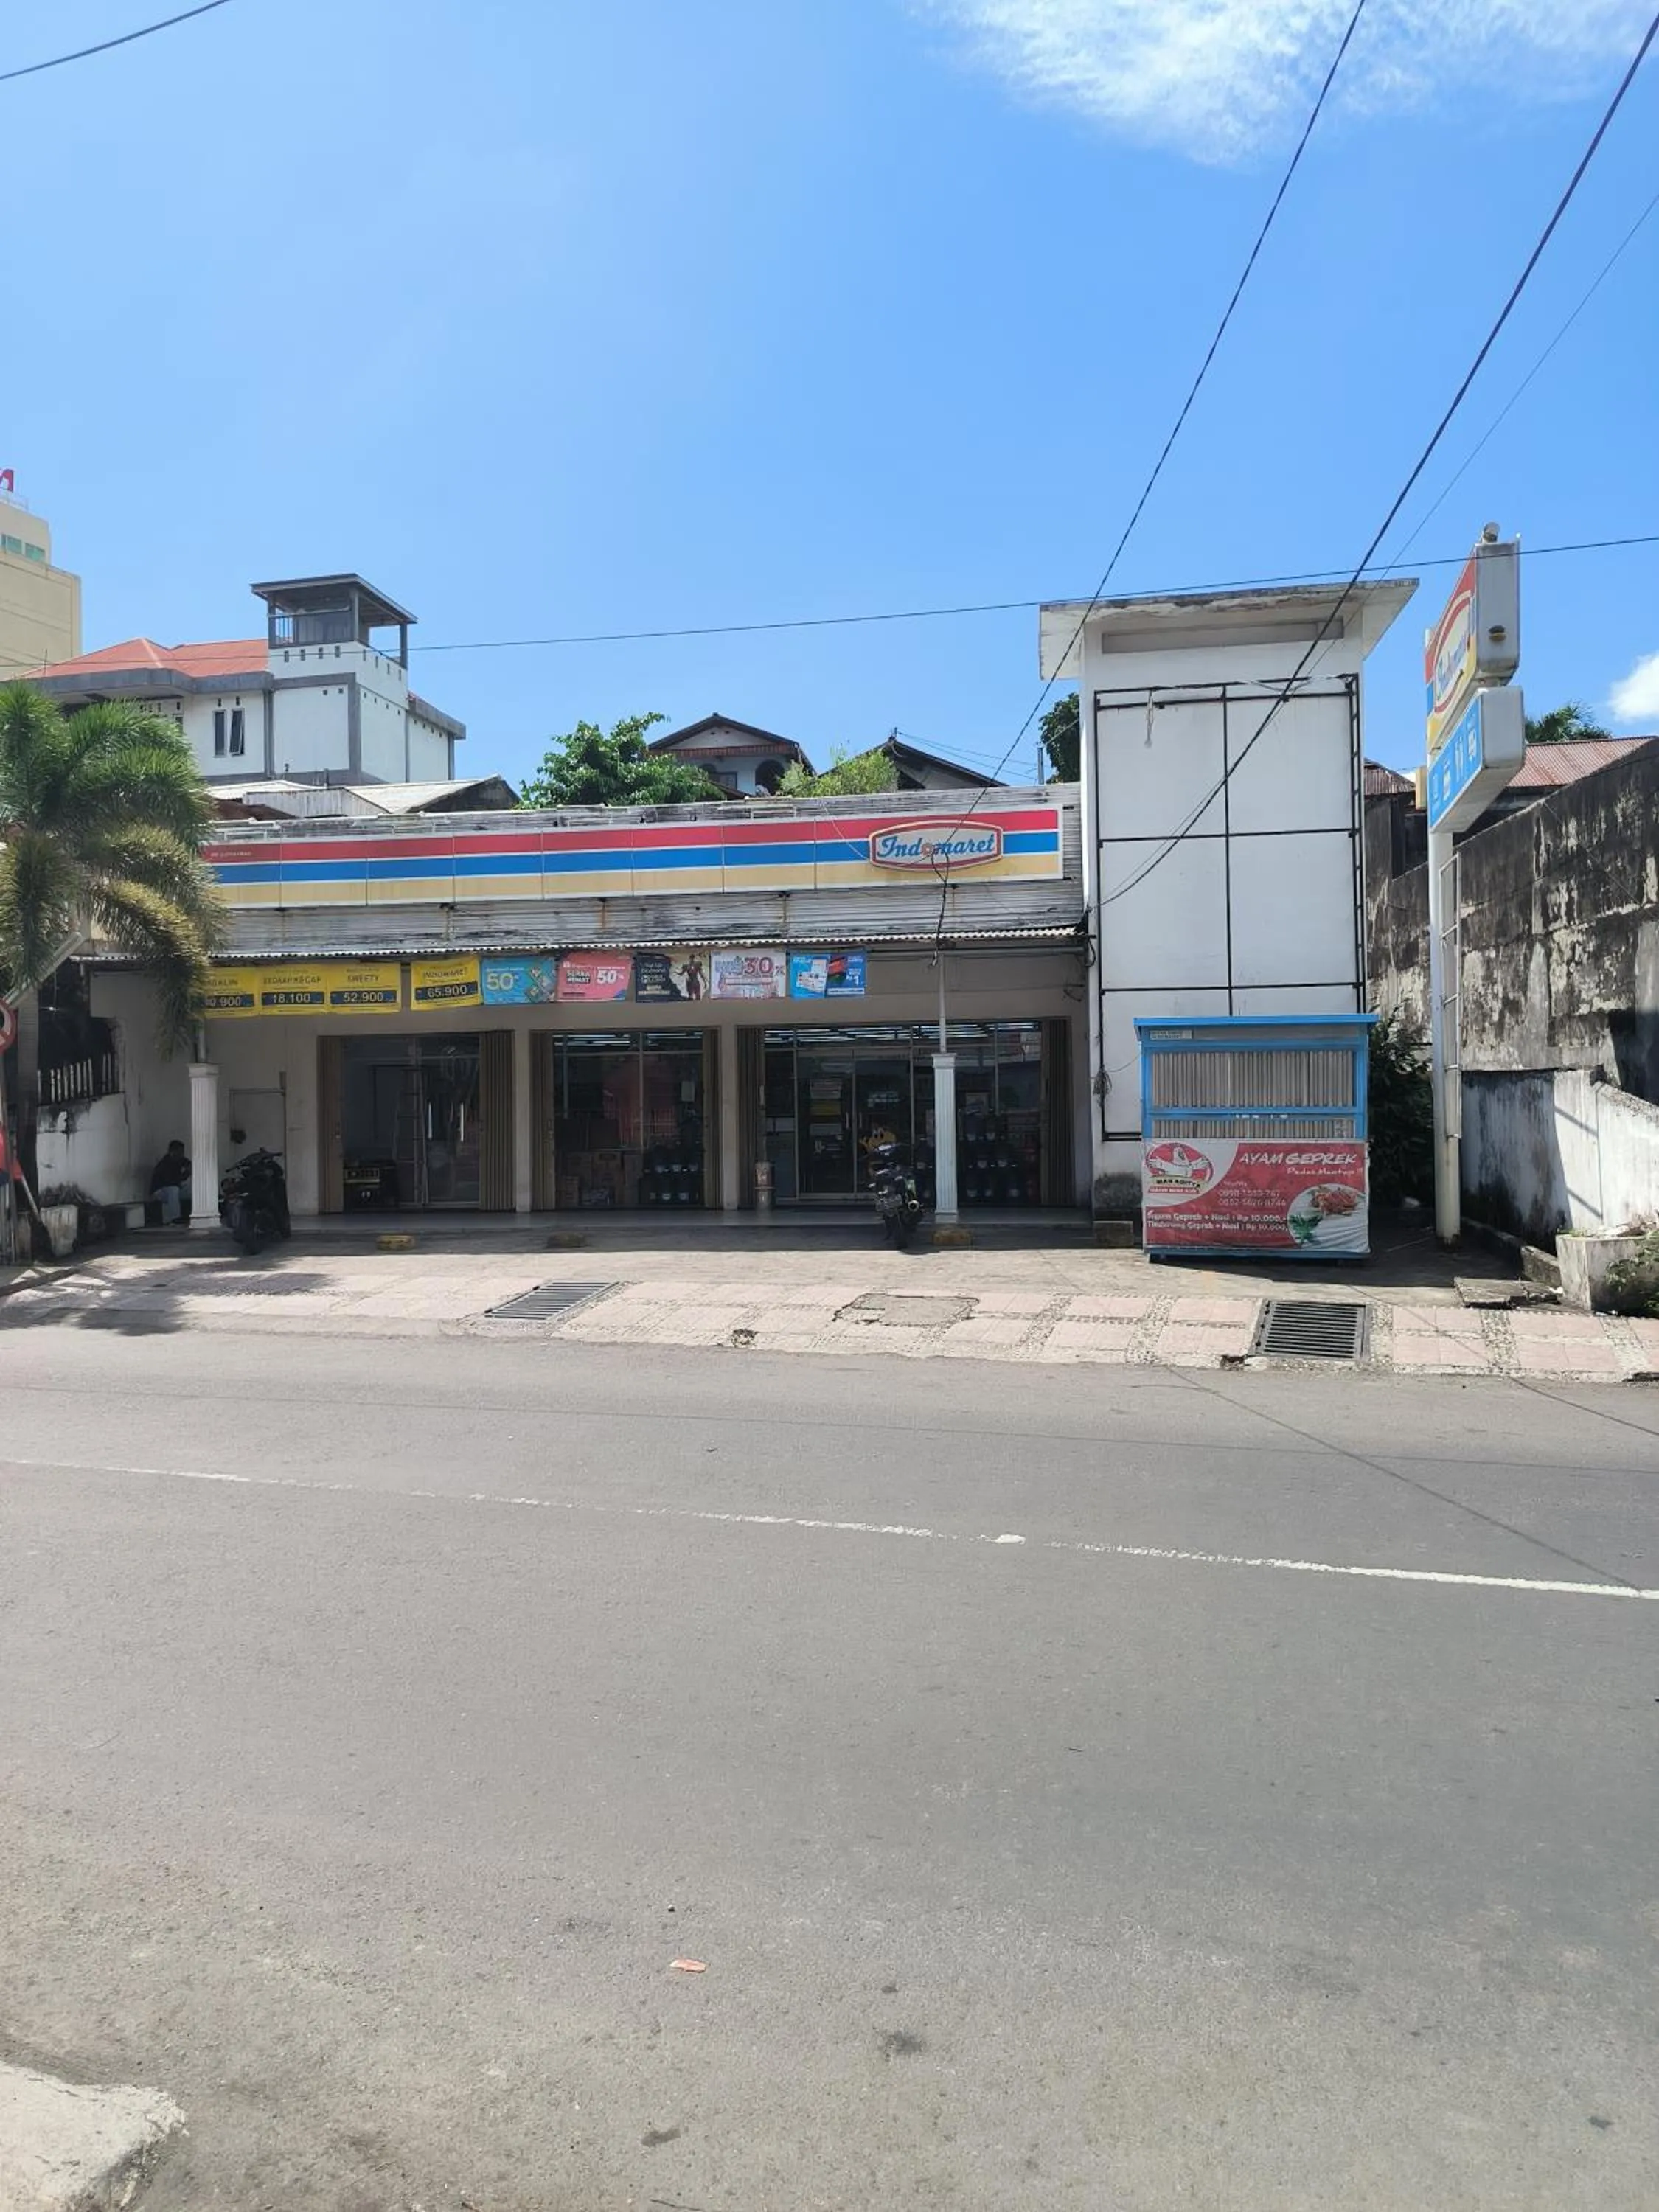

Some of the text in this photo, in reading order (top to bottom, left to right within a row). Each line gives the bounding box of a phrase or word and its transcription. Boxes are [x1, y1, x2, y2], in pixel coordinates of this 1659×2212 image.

[877, 833, 995, 858] Indmaret
[343, 992, 384, 1002] 52.900
[427, 984, 468, 998] 65.900
[273, 993, 310, 1004] 18.100
[1239, 1152, 1357, 1166] AYAM GEPREK
